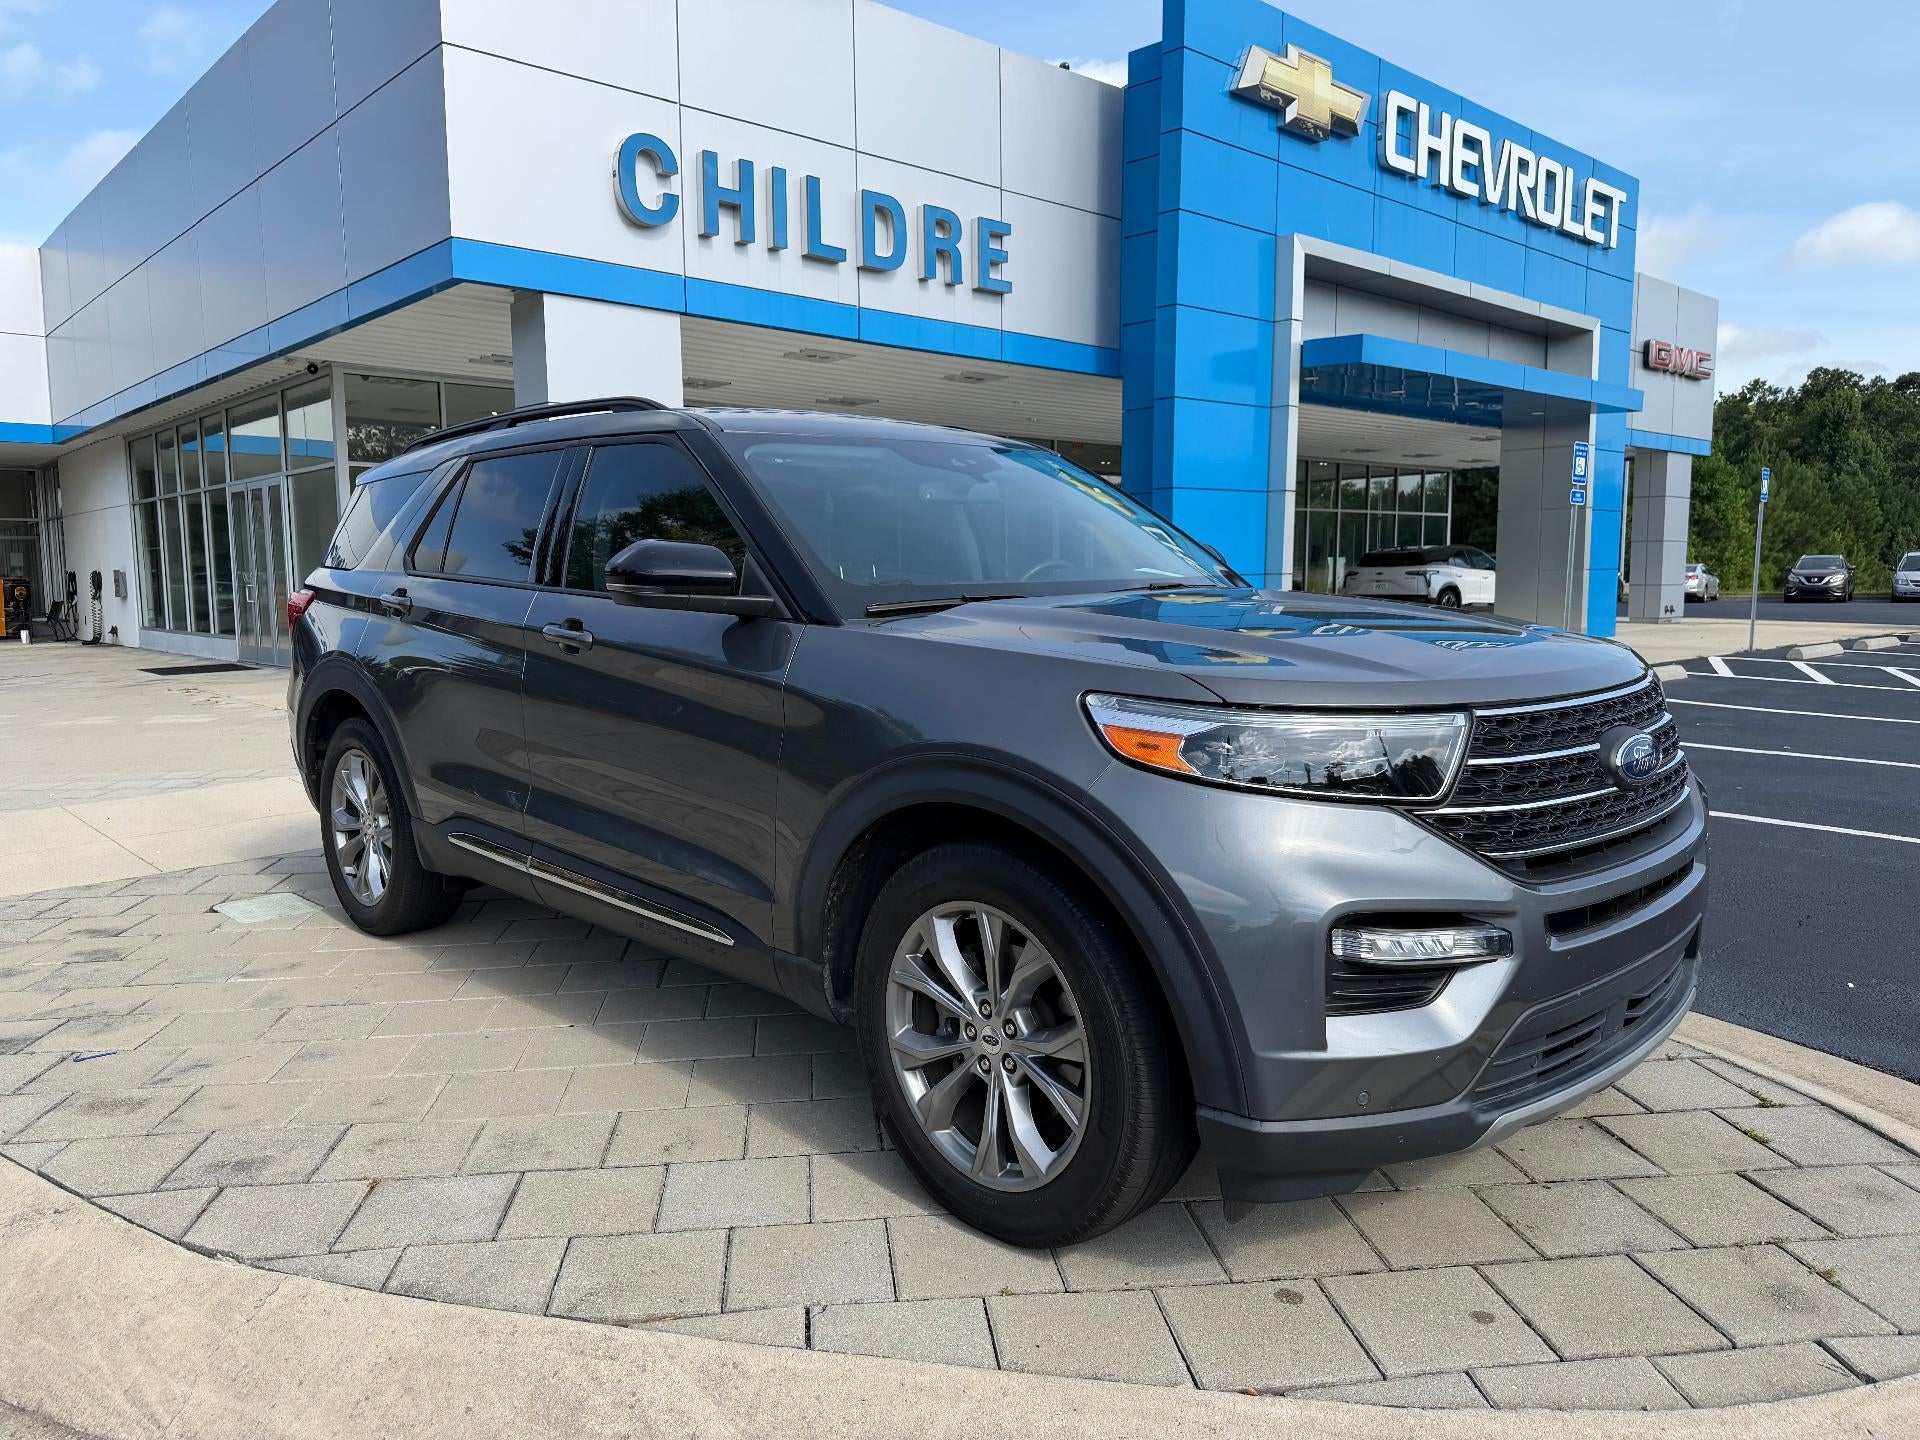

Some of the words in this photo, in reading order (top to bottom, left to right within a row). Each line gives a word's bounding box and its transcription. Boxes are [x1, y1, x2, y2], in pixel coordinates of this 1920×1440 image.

[613, 132, 1013, 295] CHILDRE
[1378, 89, 1627, 249] CHEVROLET
[1644, 339, 1712, 379] GMC
[1633, 744, 1656, 772] Ford
